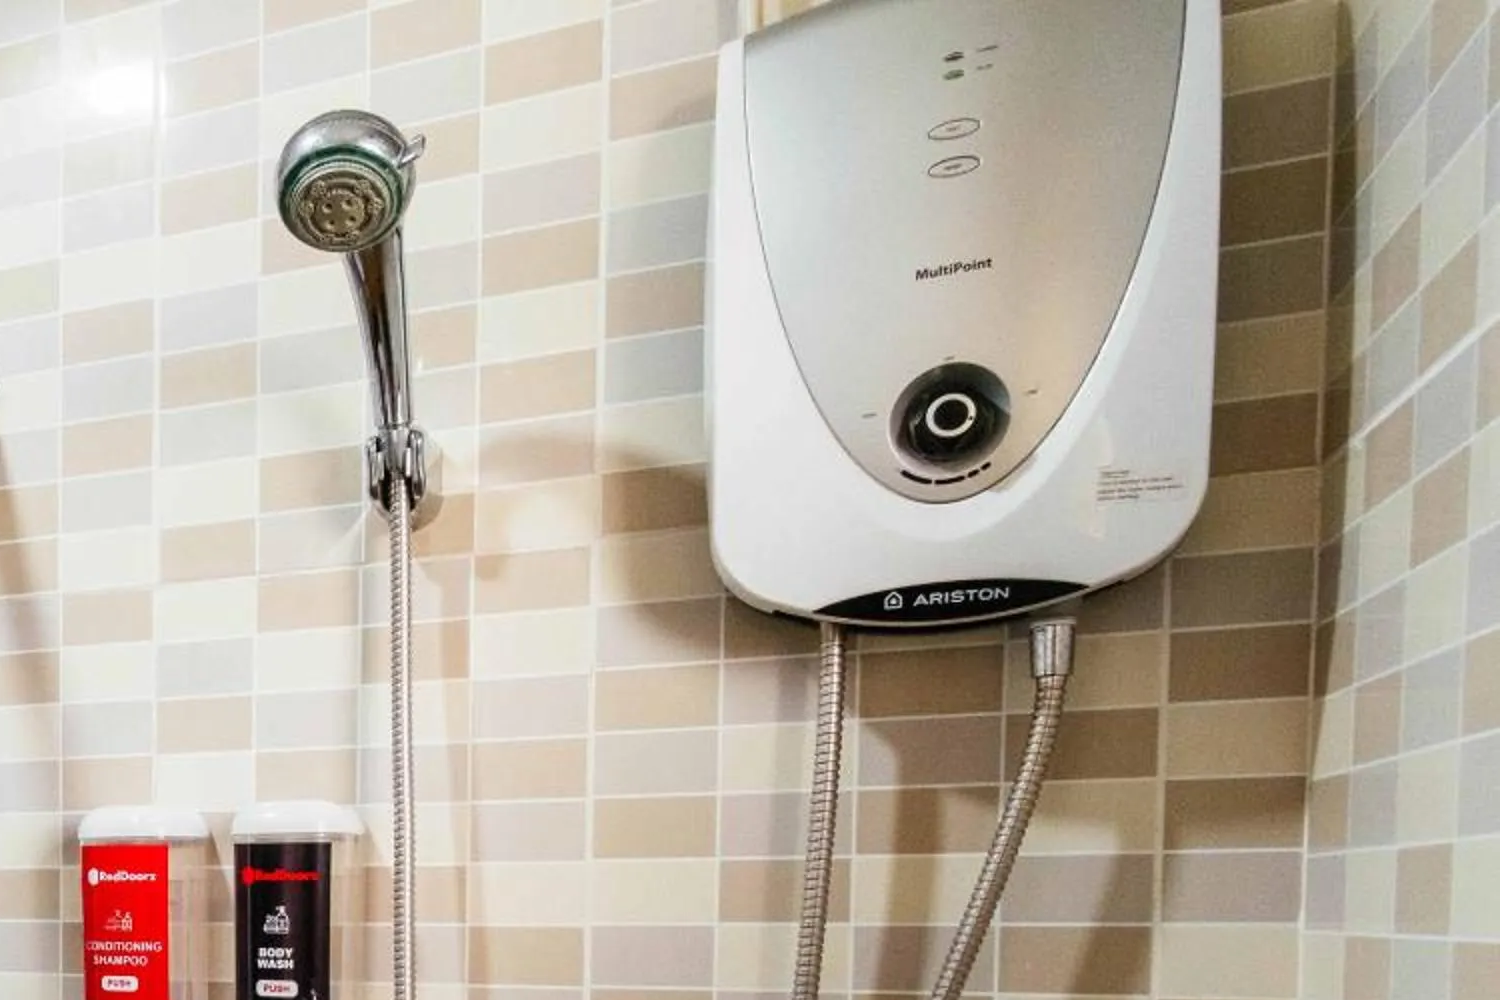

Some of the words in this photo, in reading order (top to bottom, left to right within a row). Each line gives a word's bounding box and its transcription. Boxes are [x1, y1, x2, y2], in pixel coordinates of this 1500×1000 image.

[916, 258, 992, 281] MultiPoint
[913, 587, 1010, 607] ARISTON
[87, 942, 162, 952] CONDITIONING
[259, 947, 293, 957] BODY
[93, 955, 148, 966] SHAMPOO
[257, 959, 294, 969] WASH
